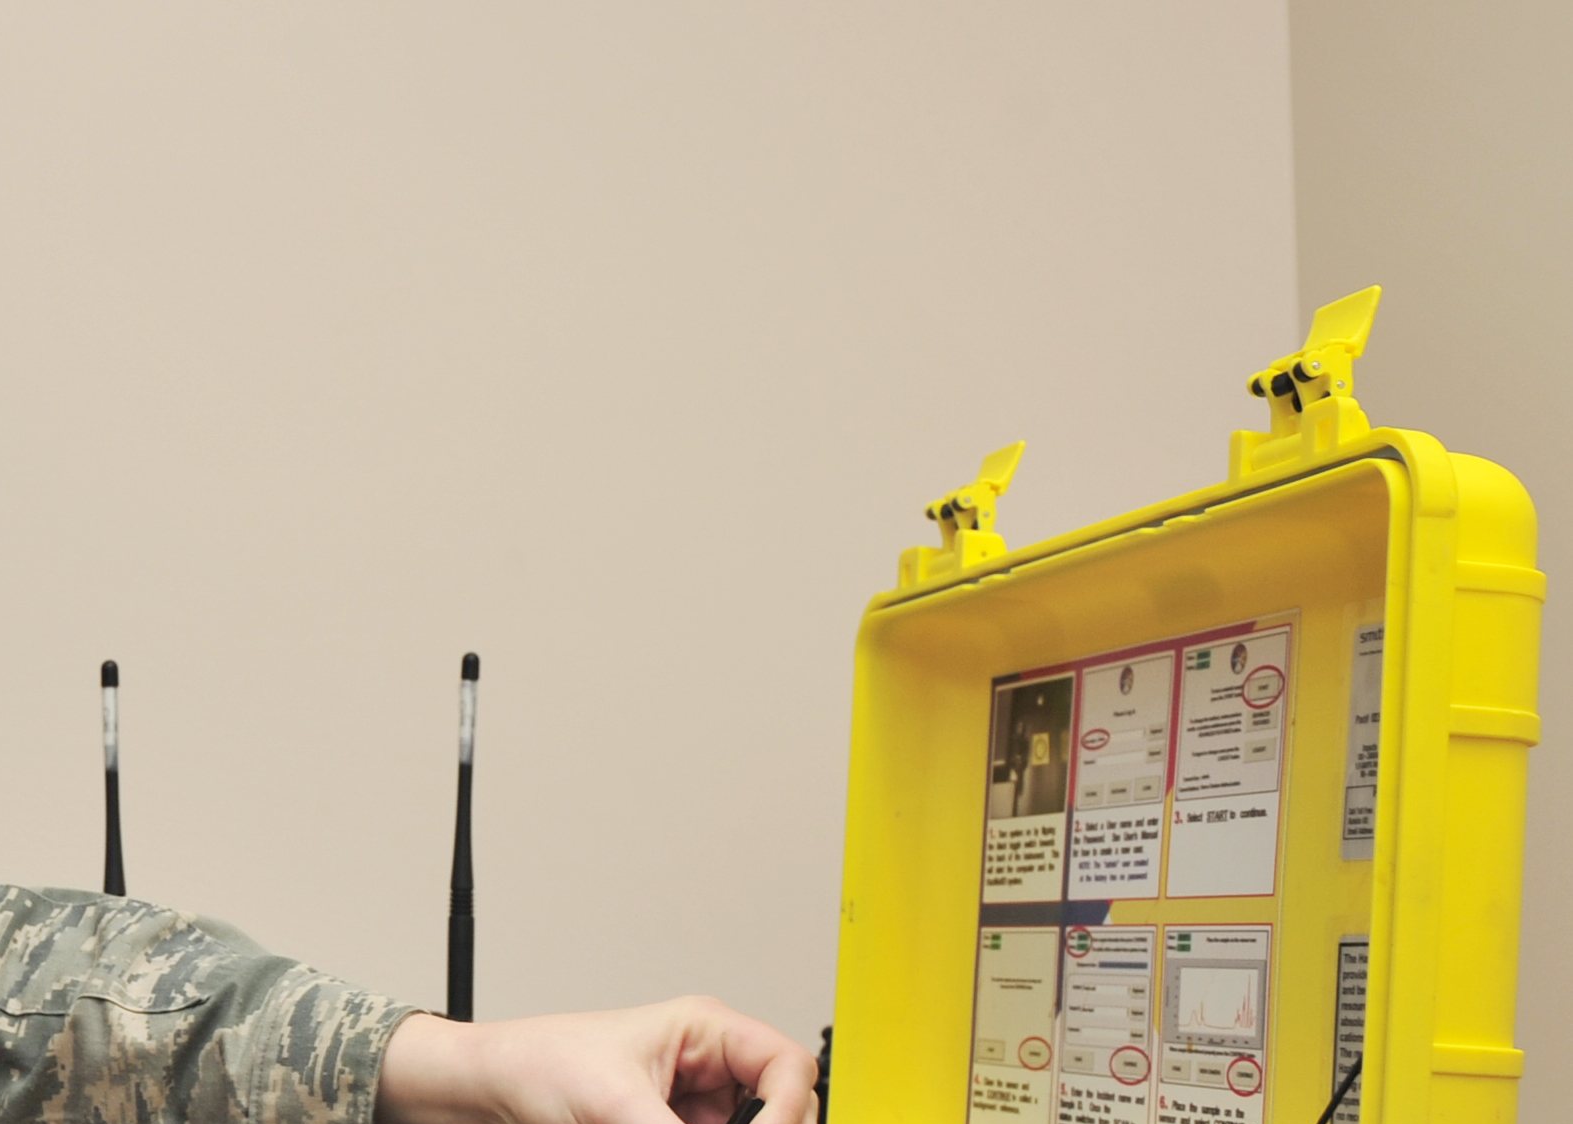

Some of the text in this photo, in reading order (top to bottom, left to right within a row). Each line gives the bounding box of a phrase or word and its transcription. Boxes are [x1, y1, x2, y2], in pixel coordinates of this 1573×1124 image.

[1174, 808, 1267, 824] 3. Select START to continue.
[987, 1089, 1011, 1102] CONTINUE
[1118, 1095, 1131, 1103] name
[1135, 1095, 1145, 1105] and
[1160, 1096, 1244, 1119] 6. Place the sample on the
[1159, 1115, 1176, 1123] sensor
